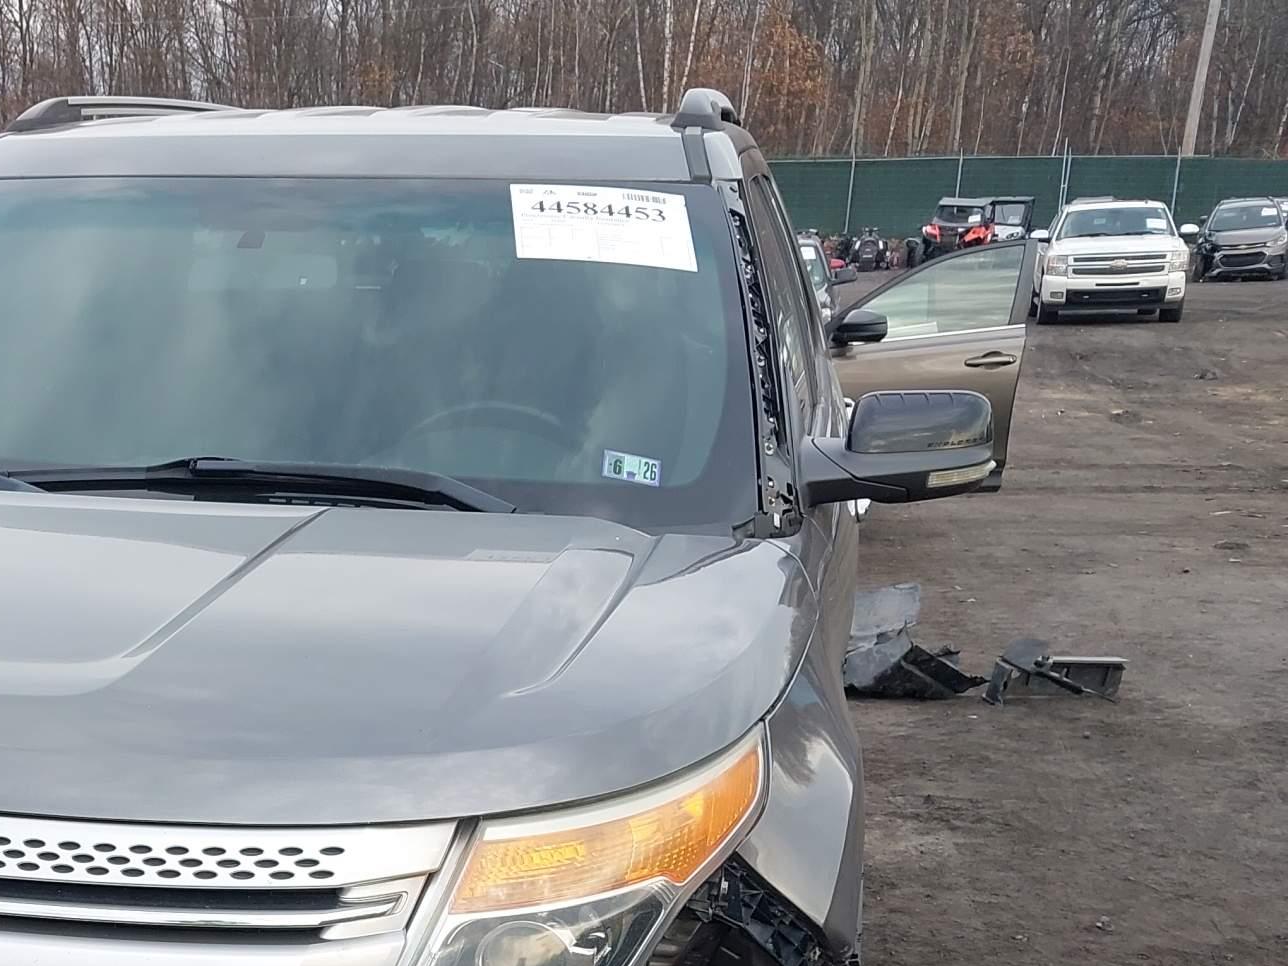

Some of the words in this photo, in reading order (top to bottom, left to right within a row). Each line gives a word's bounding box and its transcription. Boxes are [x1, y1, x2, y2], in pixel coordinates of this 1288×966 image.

[531, 200, 666, 223] 44584453
[613, 459, 622, 476] 6
[643, 461, 657, 481] 26
